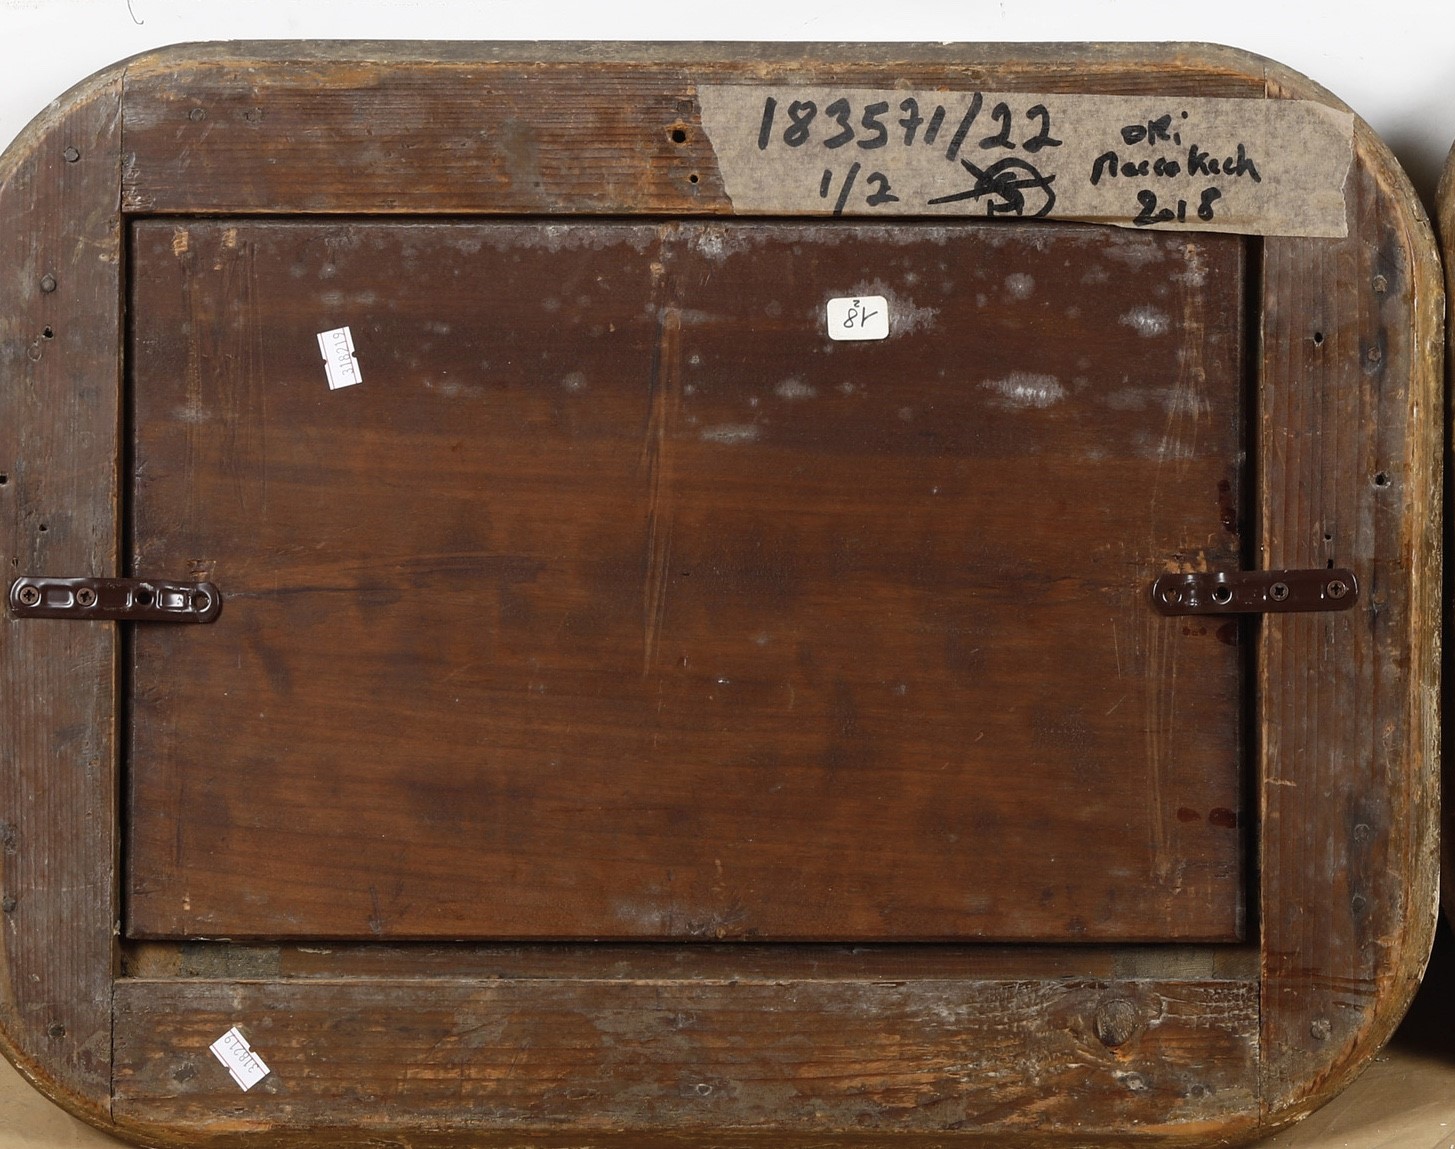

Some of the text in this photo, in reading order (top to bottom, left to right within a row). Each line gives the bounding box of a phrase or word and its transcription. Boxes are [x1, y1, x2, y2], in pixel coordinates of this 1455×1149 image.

[757, 90, 1064, 162] 183571/22
[819, 161, 900, 217] 1/2
[332, 332, 355, 376] 318219
[224, 1034, 260, 1074] 318219
